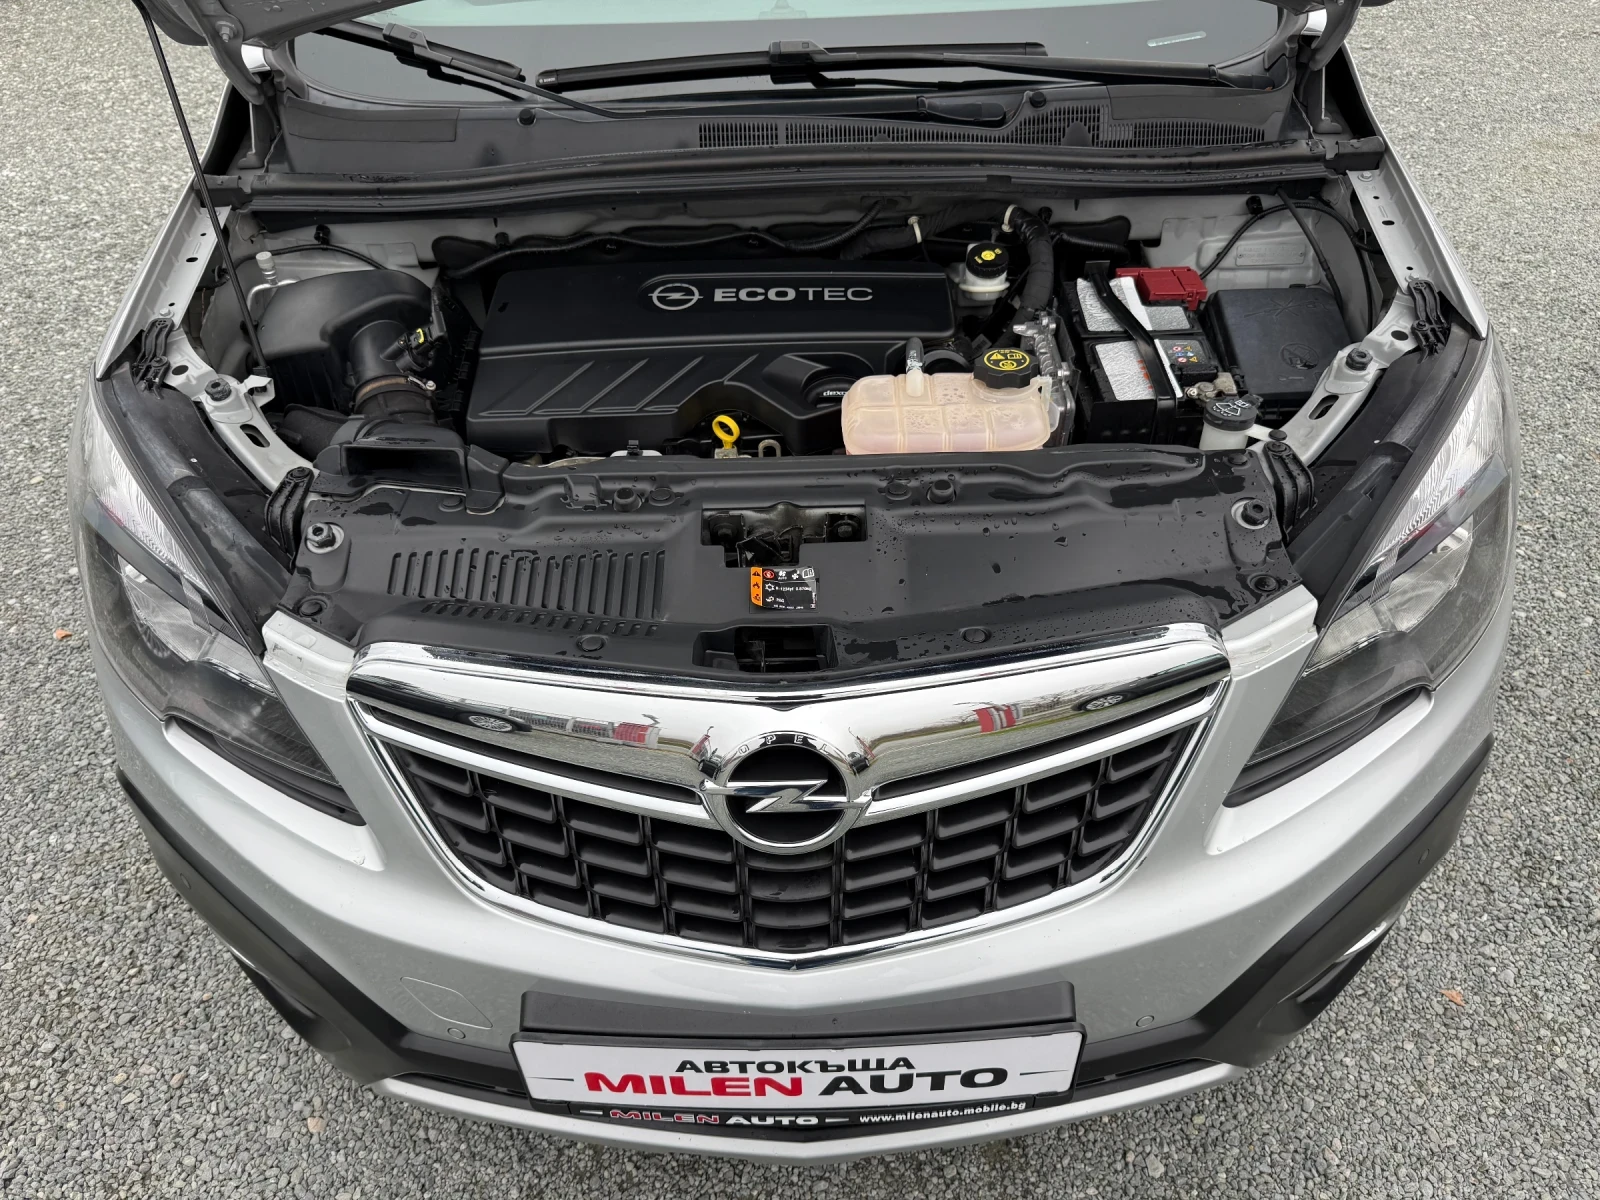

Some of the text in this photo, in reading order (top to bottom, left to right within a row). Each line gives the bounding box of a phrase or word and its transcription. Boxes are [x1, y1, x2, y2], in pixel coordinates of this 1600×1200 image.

[714, 287, 873, 302] ECOTEC
[738, 733, 829, 755] OPEL
[584, 1067, 1008, 1097] MILEN AUTO
[609, 1101, 1026, 1126] MILEN AUTO www.milenauto.mobile.bg
